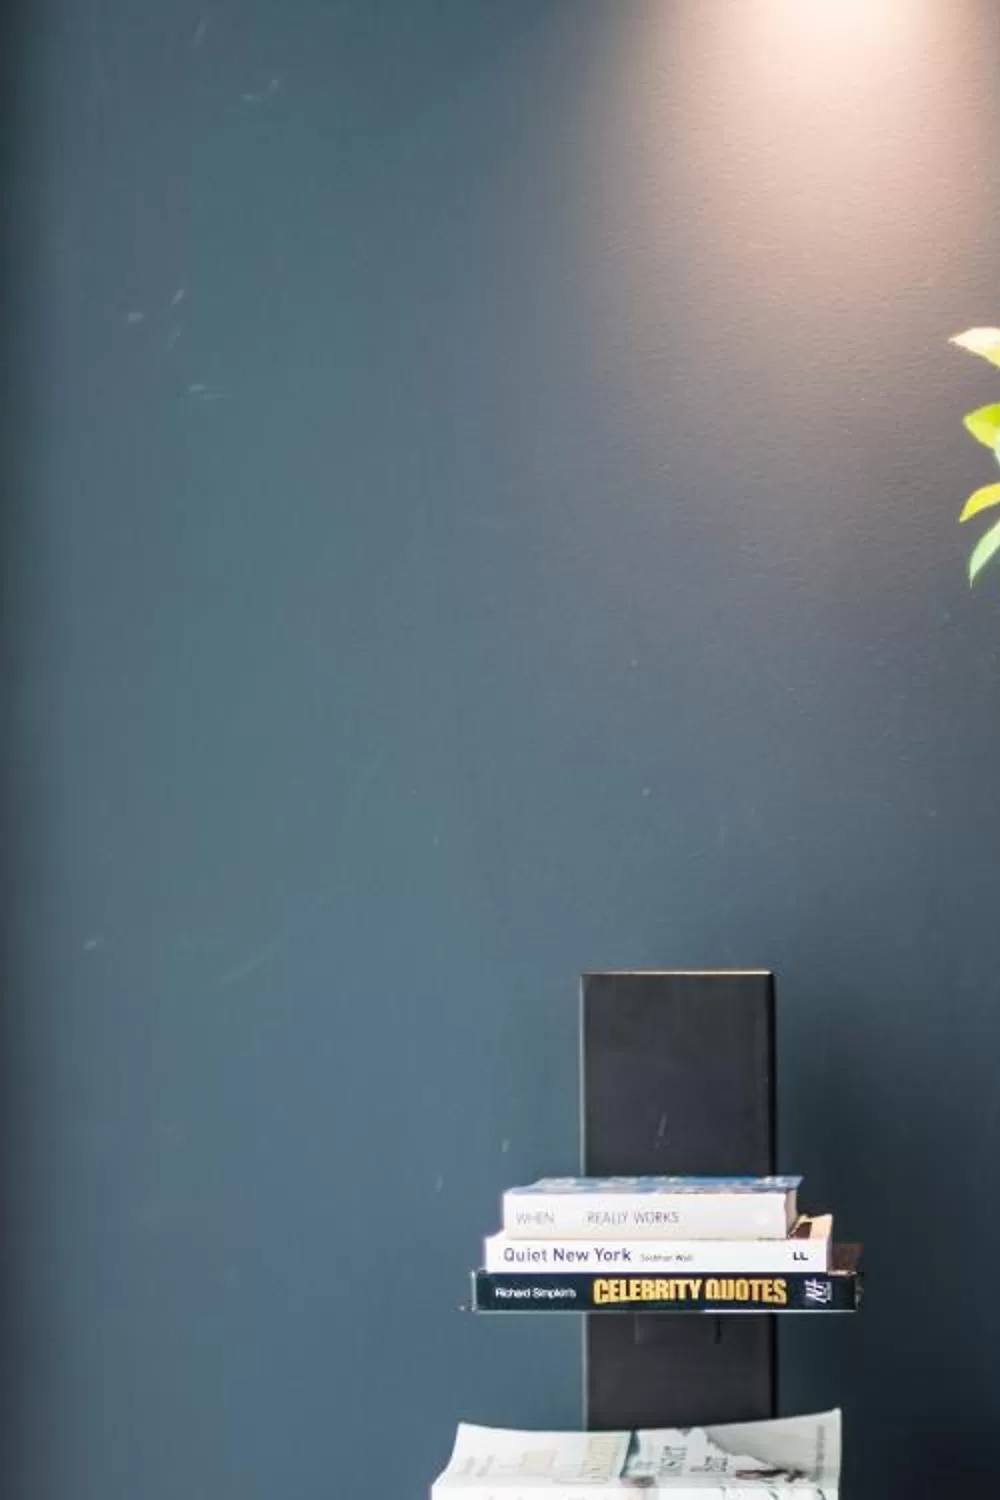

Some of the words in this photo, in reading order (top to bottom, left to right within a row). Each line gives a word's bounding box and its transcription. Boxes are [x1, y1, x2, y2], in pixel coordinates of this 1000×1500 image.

[633, 1211, 680, 1224] WORKS
[503, 1247, 548, 1263] Quiet
[553, 1247, 589, 1262] New
[595, 1247, 632, 1262] York
[593, 1278, 701, 1305] CELEBRITY
[705, 1278, 788, 1304] QUOTES
